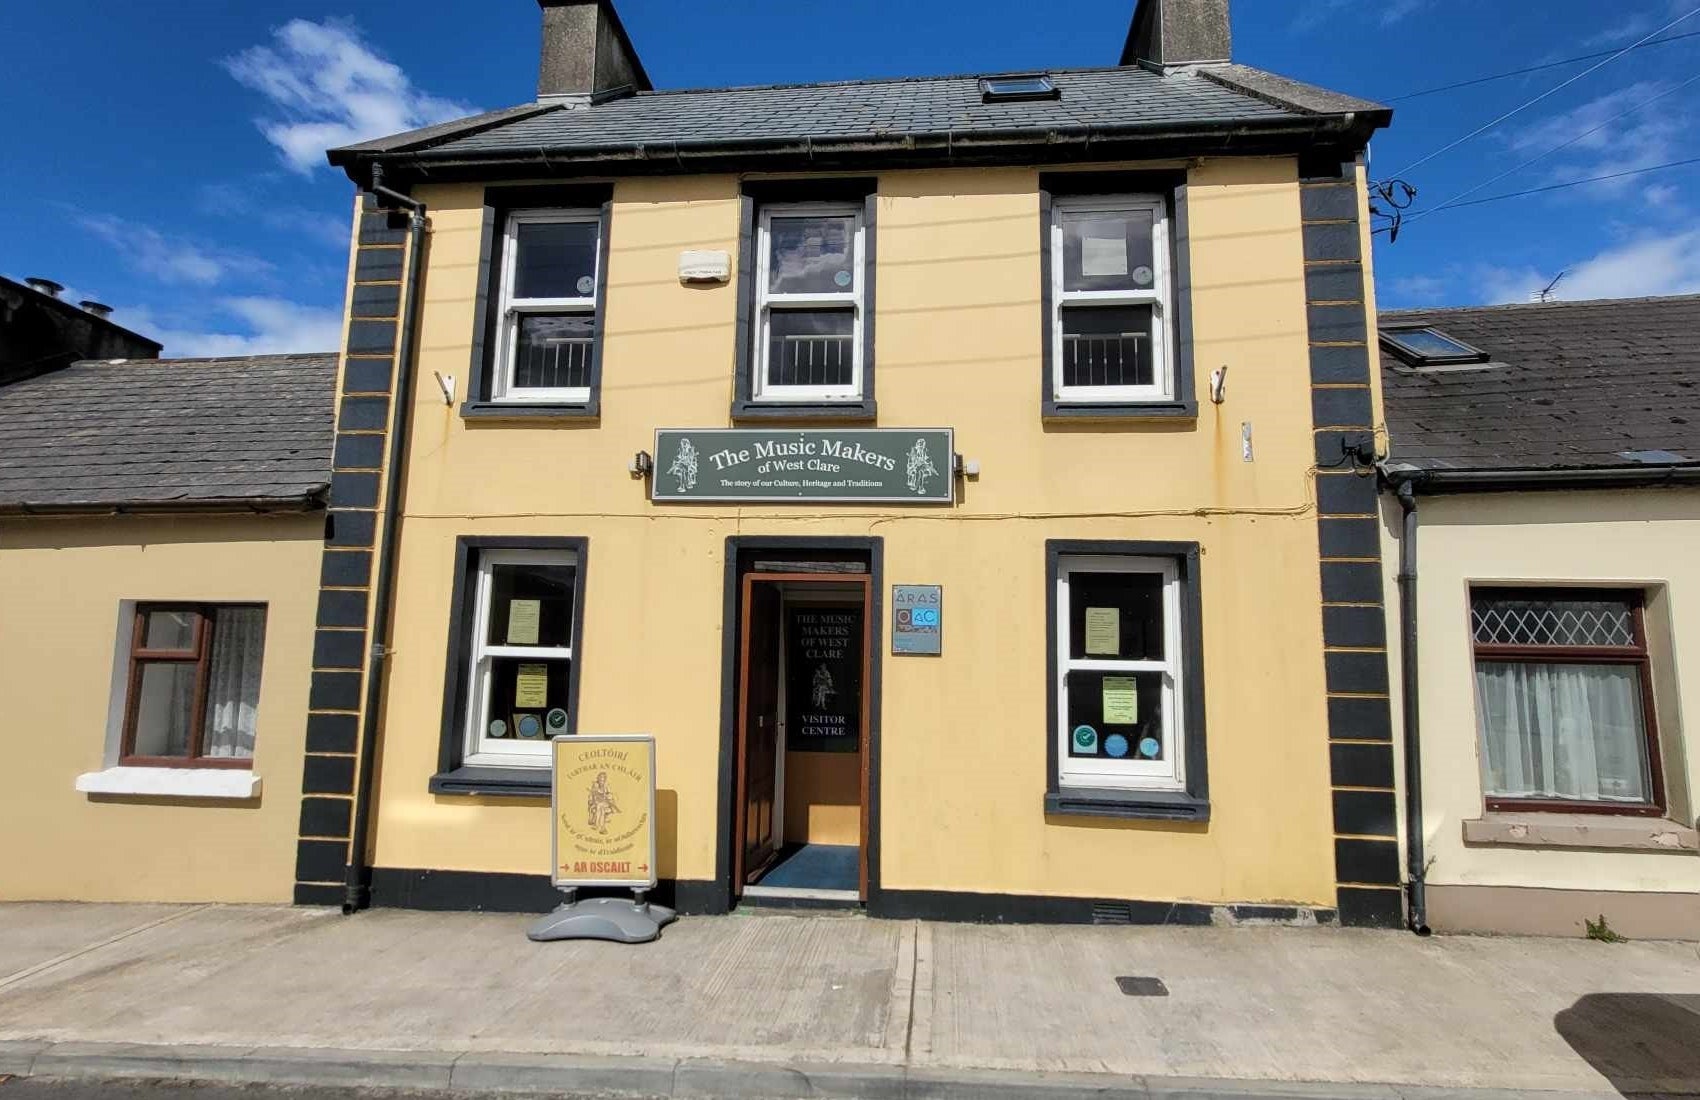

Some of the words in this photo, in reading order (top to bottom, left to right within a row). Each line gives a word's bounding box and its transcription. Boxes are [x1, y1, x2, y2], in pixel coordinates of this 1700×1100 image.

[709, 449, 750, 471] The
[753, 437, 816, 459] Music
[821, 439, 896, 471] Makers
[758, 461, 771, 474] of
[773, 460, 804, 471] West
[807, 459, 840, 473] Clare
[720, 479, 734, 487] The
[734, 480, 752, 488] story
[752, 479, 761, 487] of
[802, 479, 832, 489] Heritage
[832, 479, 846, 487] and
[846, 479, 883, 487] Traditions
[797, 615, 818, 624] THE
[820, 615, 855, 624] MUSIC
[801, 626, 849, 636] MAKERS
[801, 638, 817, 647] OF
[818, 638, 849, 648] WEST
[806, 649, 844, 659] CLARE
[801, 714, 846, 724] VISITOR
[801, 726, 846, 736] CENTRE
[573, 862, 588, 873] AR
[590, 862, 632, 873] OSCAILT
